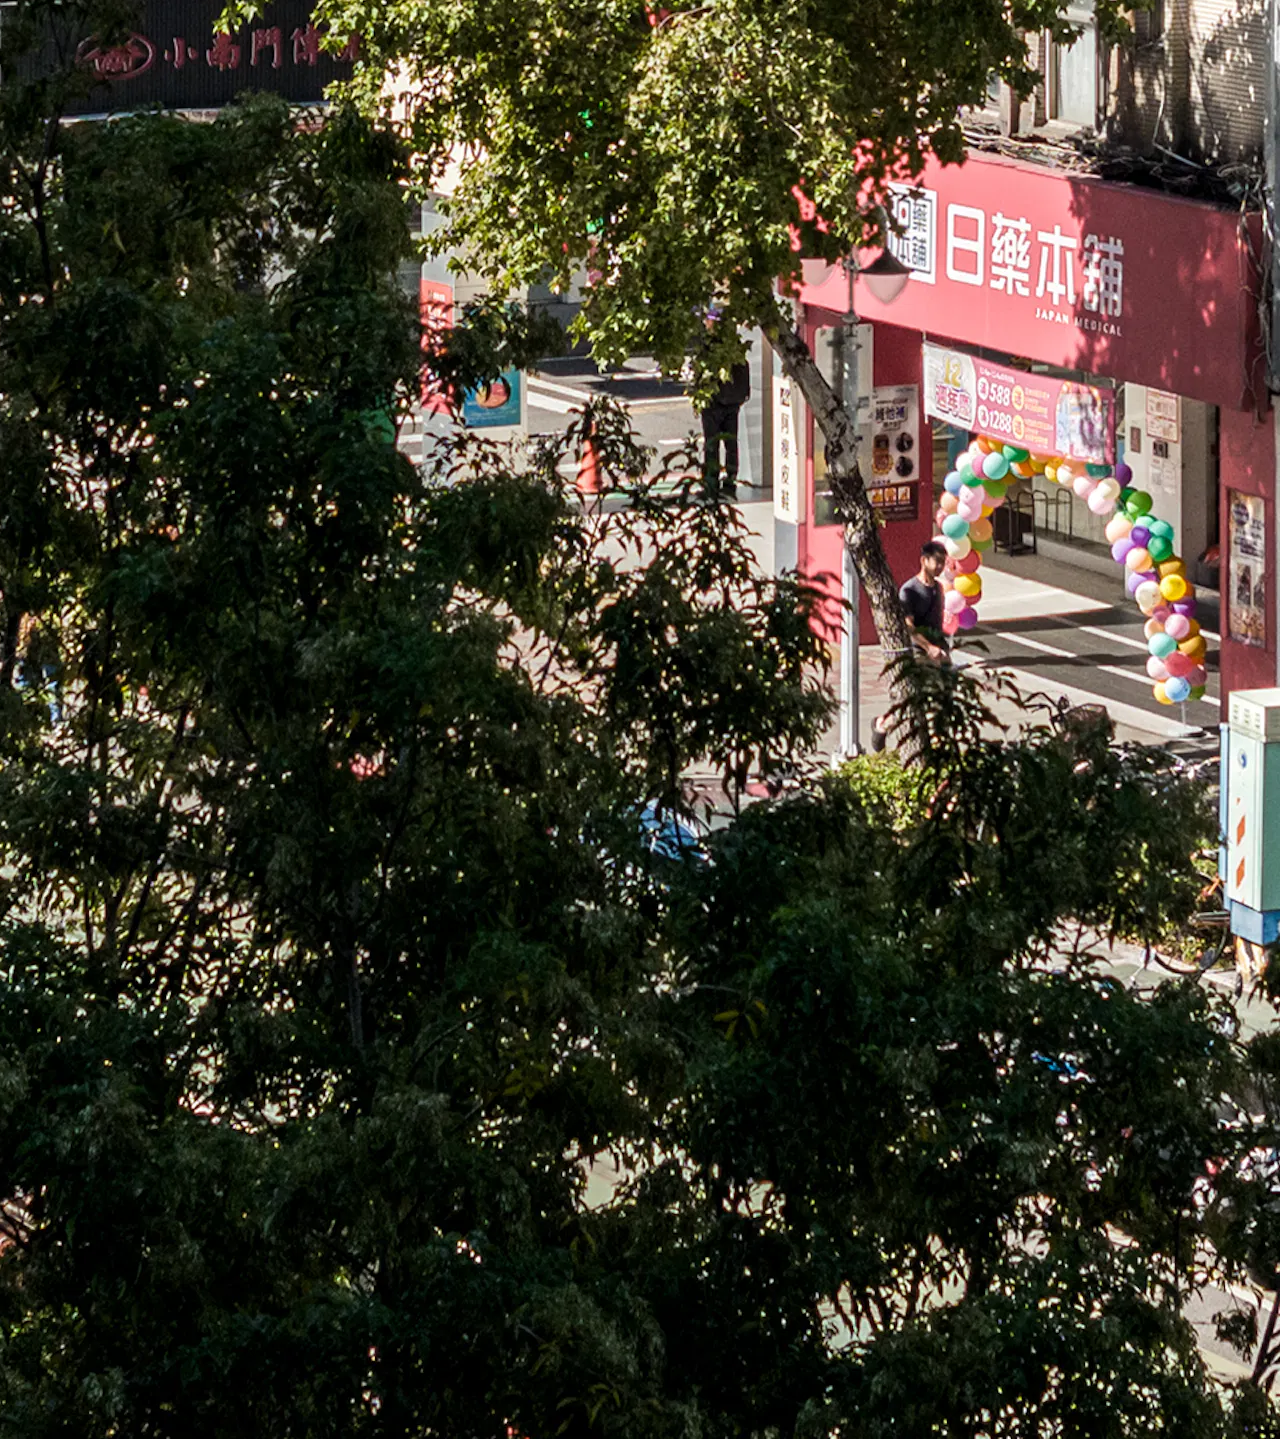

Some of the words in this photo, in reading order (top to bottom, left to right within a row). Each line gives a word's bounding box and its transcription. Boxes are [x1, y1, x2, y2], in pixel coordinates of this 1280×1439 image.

[946, 202, 1125, 318] 日藥本舖
[1035, 307, 1070, 325] JAPAN
[1075, 316, 1123, 337] MEDICAL
[989, 382, 1011, 407] 588
[988, 410, 1013, 434] 1288
